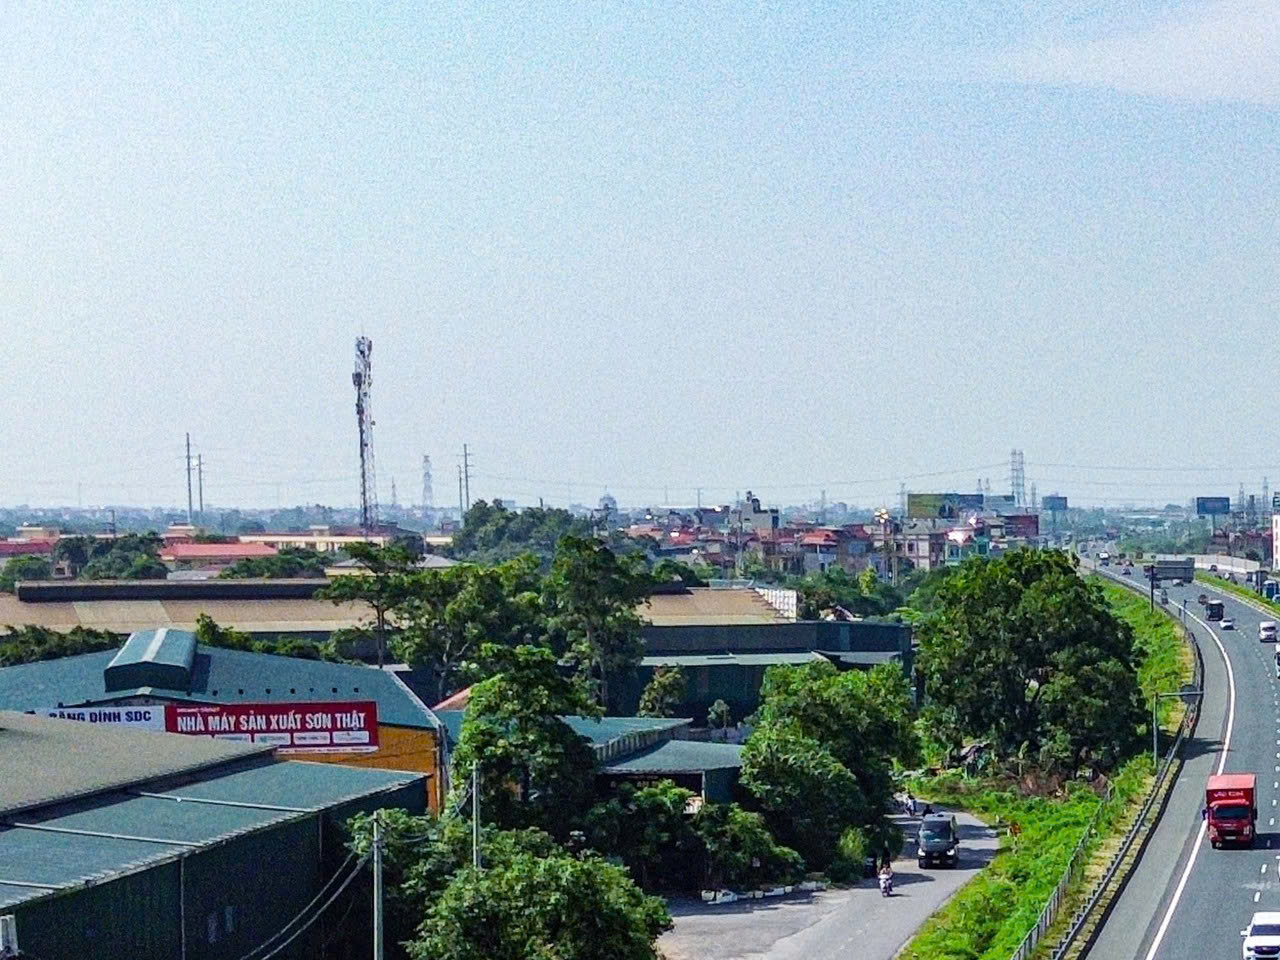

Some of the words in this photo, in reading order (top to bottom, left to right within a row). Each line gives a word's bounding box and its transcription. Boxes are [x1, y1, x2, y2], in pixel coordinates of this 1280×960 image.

[125, 710, 152, 722] SDC
[177, 712, 205, 732] NHÀ
[207, 711, 236, 731] MÁY
[239, 709, 266, 731] SẢN
[269, 709, 302, 730] XUẤT
[305, 712, 332, 729] SƠN
[334, 709, 366, 731] THẬT
